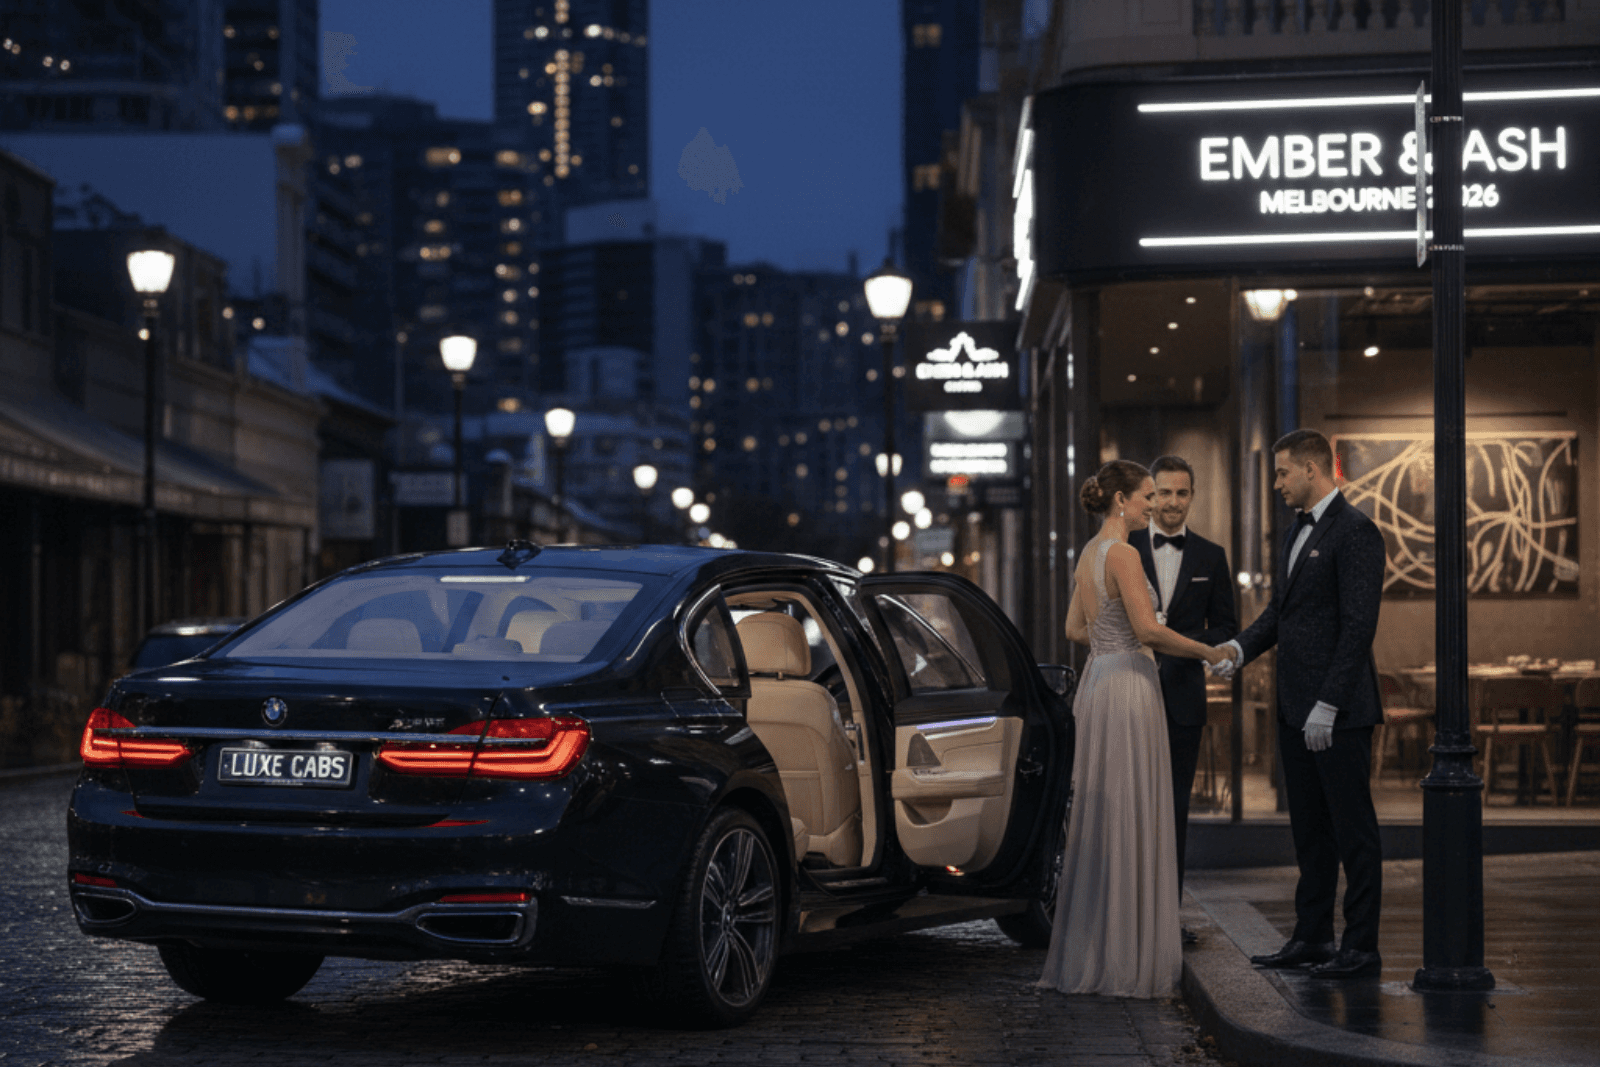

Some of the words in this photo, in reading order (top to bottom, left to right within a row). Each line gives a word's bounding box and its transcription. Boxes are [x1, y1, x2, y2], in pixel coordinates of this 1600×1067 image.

[1199, 132, 1383, 181] EMBER
[1398, 131, 1433, 175] &
[1461, 126, 1567, 172] ASH
[1259, 186, 1417, 214] MELBOURNE
[230, 753, 285, 777] LUXE
[291, 754, 345, 779] CABS
